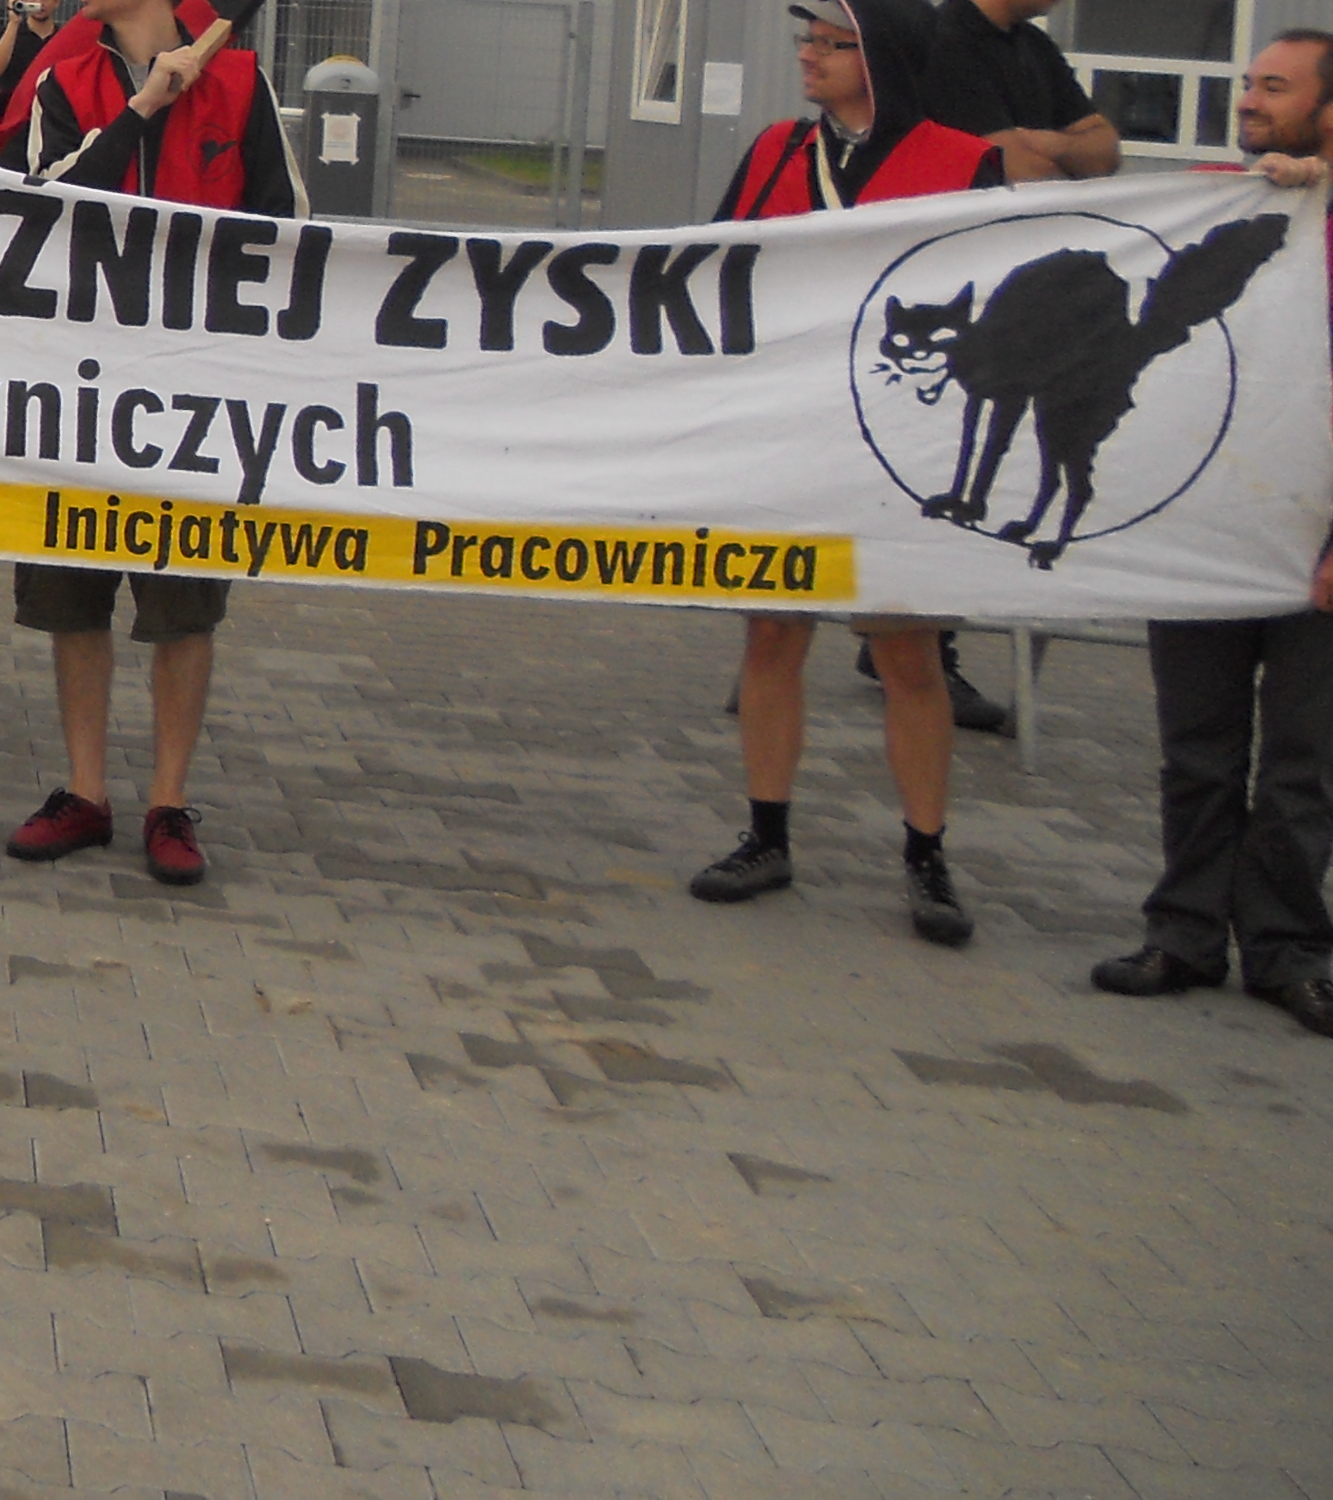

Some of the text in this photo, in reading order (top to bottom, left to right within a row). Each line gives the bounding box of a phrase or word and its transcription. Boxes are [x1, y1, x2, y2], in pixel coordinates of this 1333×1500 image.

[374, 231, 763, 356] ZYSKI
[43, 491, 818, 593] Inicjatywa Pracownicza
